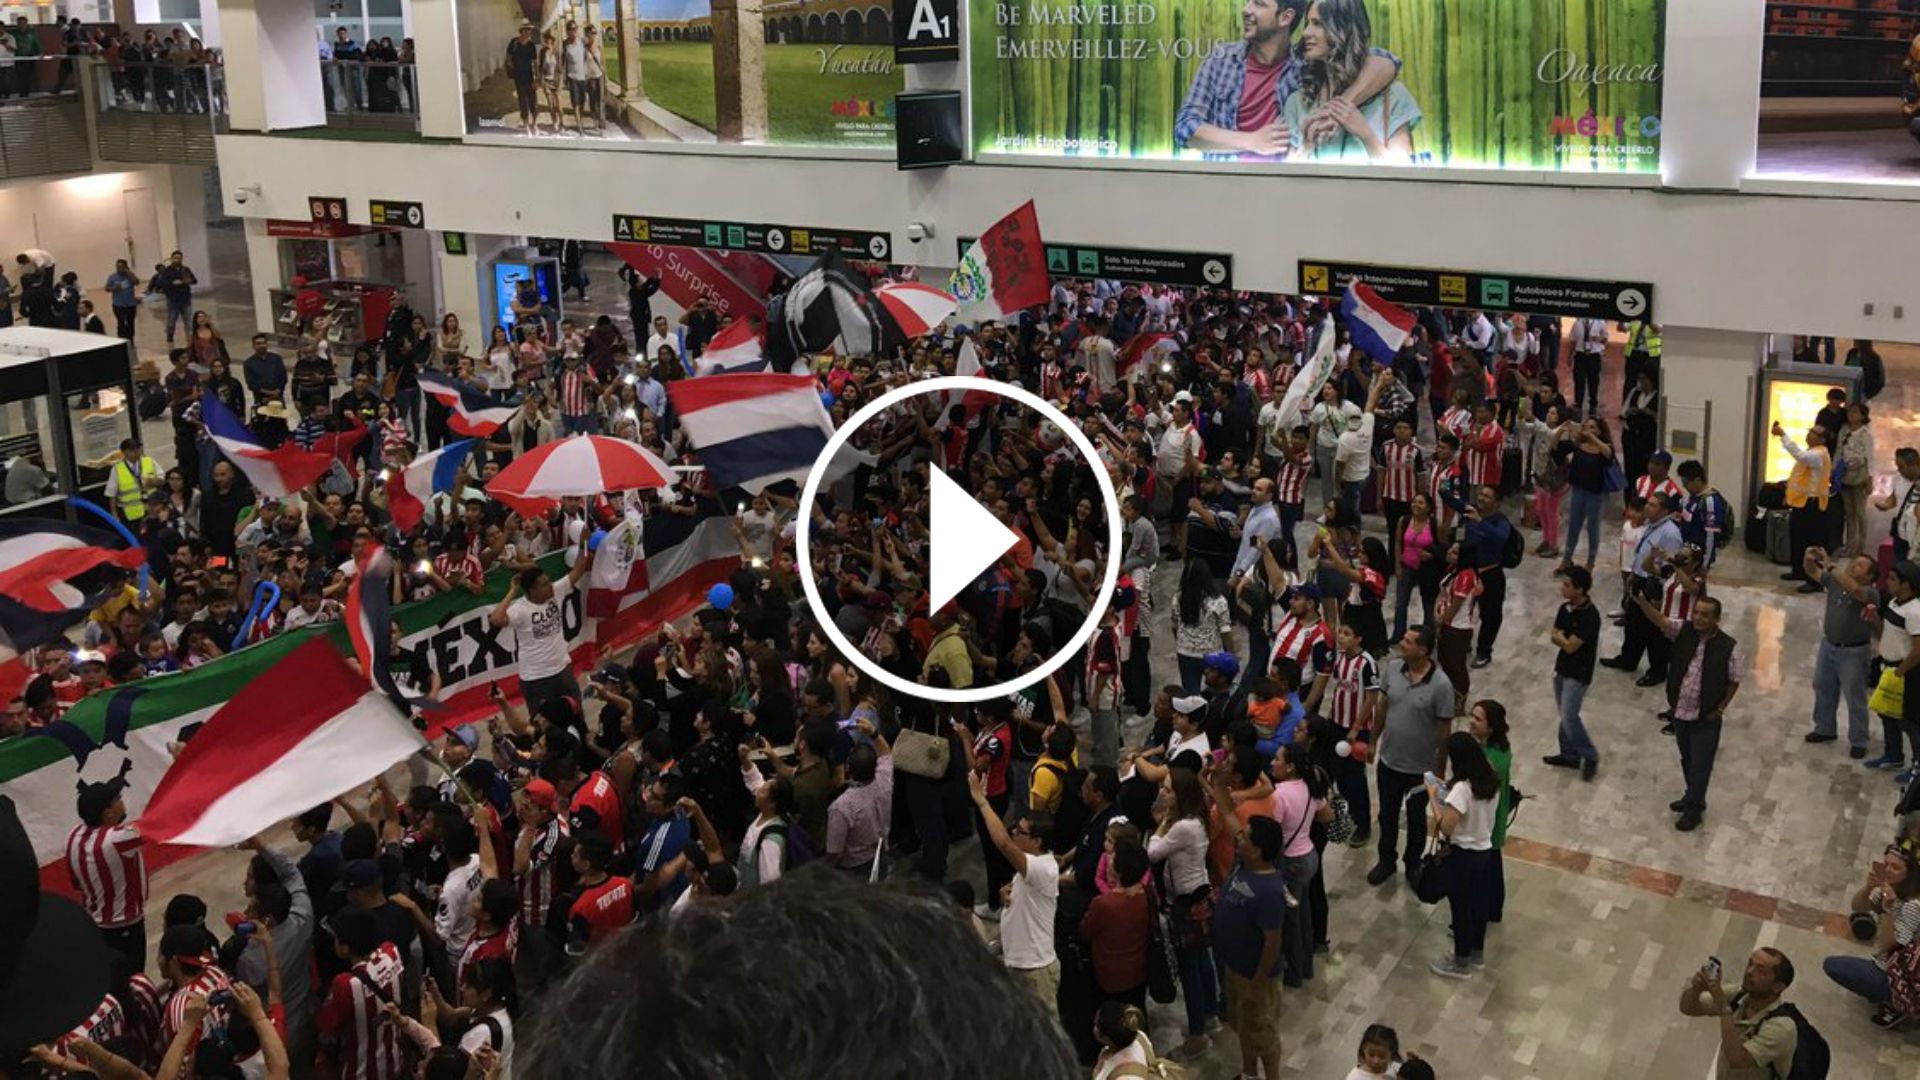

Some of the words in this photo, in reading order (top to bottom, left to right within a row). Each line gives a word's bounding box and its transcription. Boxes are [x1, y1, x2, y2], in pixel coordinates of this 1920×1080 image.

[815, 44, 894, 75] Yucatán
[996, 36, 1226, 60] EMERVEILLEZ-VOUS
[1537, 48, 1664, 98] Oaxaca
[618, 218, 630, 234] A
[665, 252, 730, 314] Surprise
[1514, 285, 1563, 297] Autobuses
[1565, 287, 1610, 301] Foráneos
